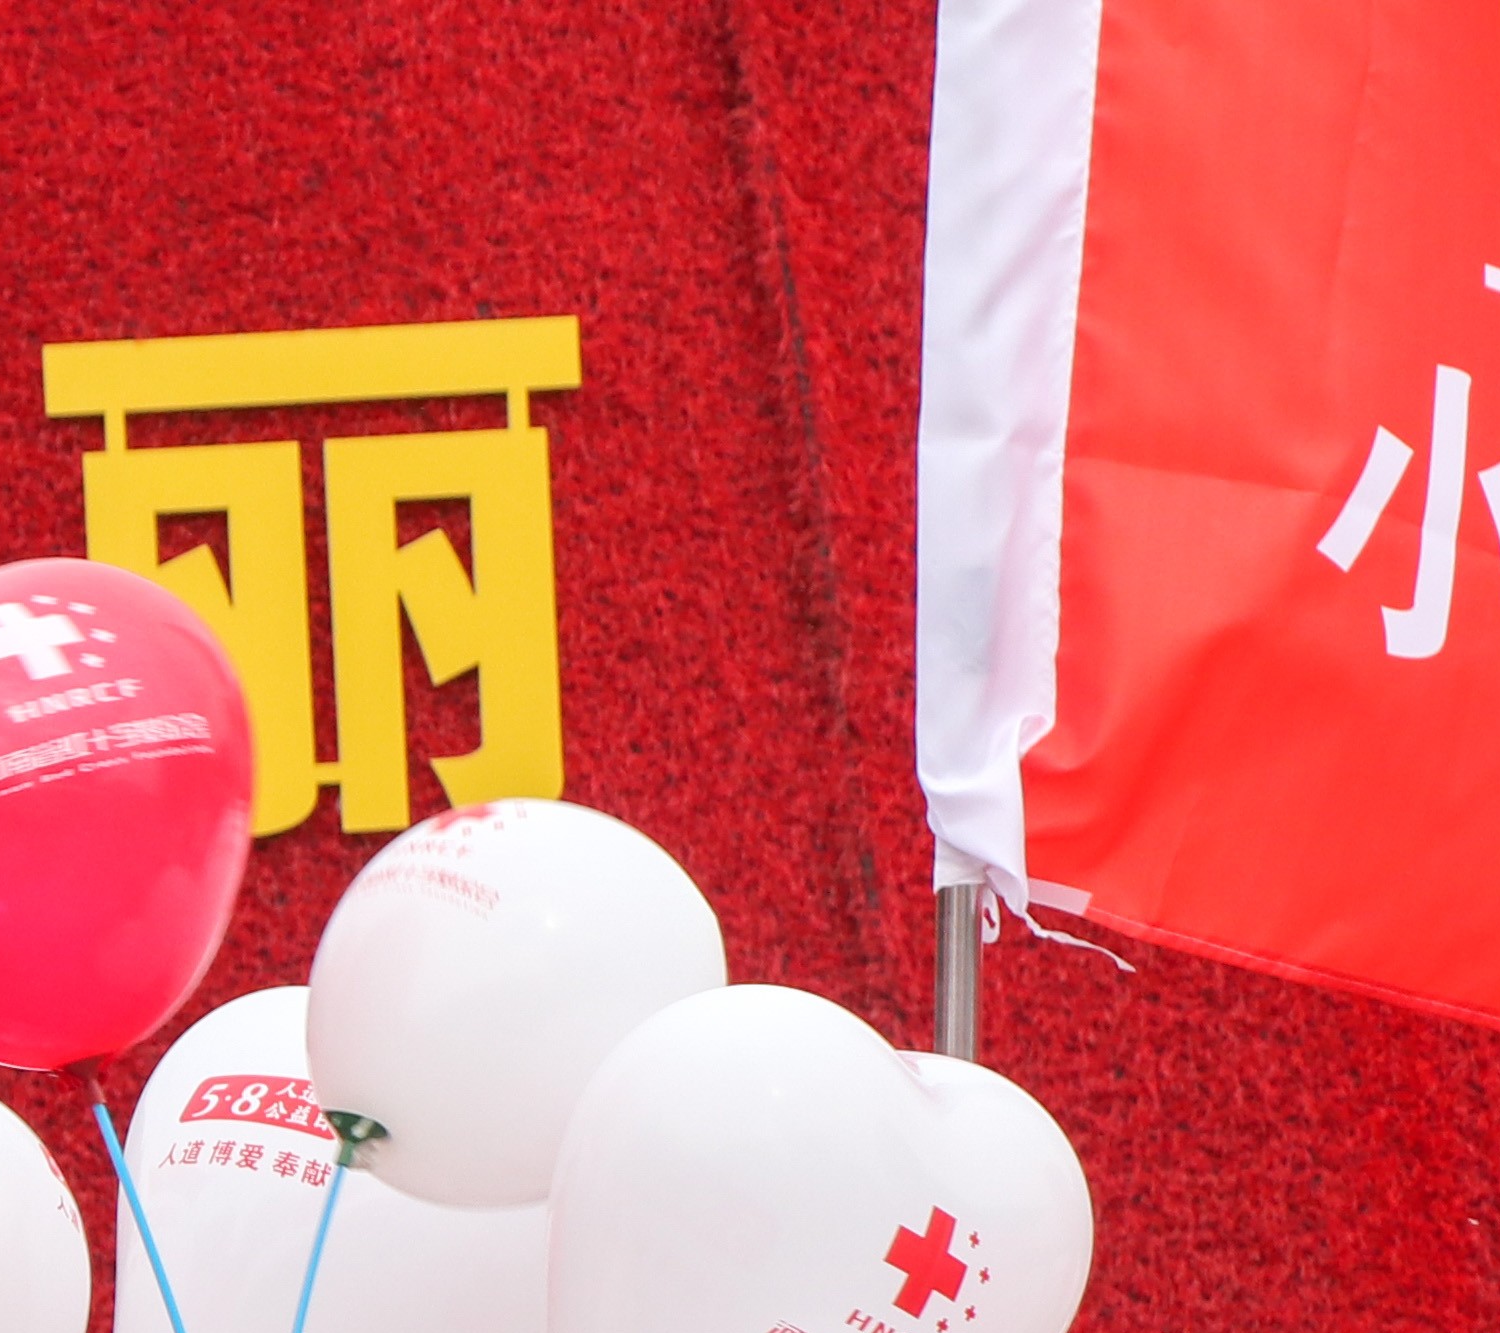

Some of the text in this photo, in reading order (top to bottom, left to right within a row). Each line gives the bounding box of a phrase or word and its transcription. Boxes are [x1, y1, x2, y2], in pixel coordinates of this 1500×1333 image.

[159, 1140, 332, 1186] 人道 博爱 奉献
